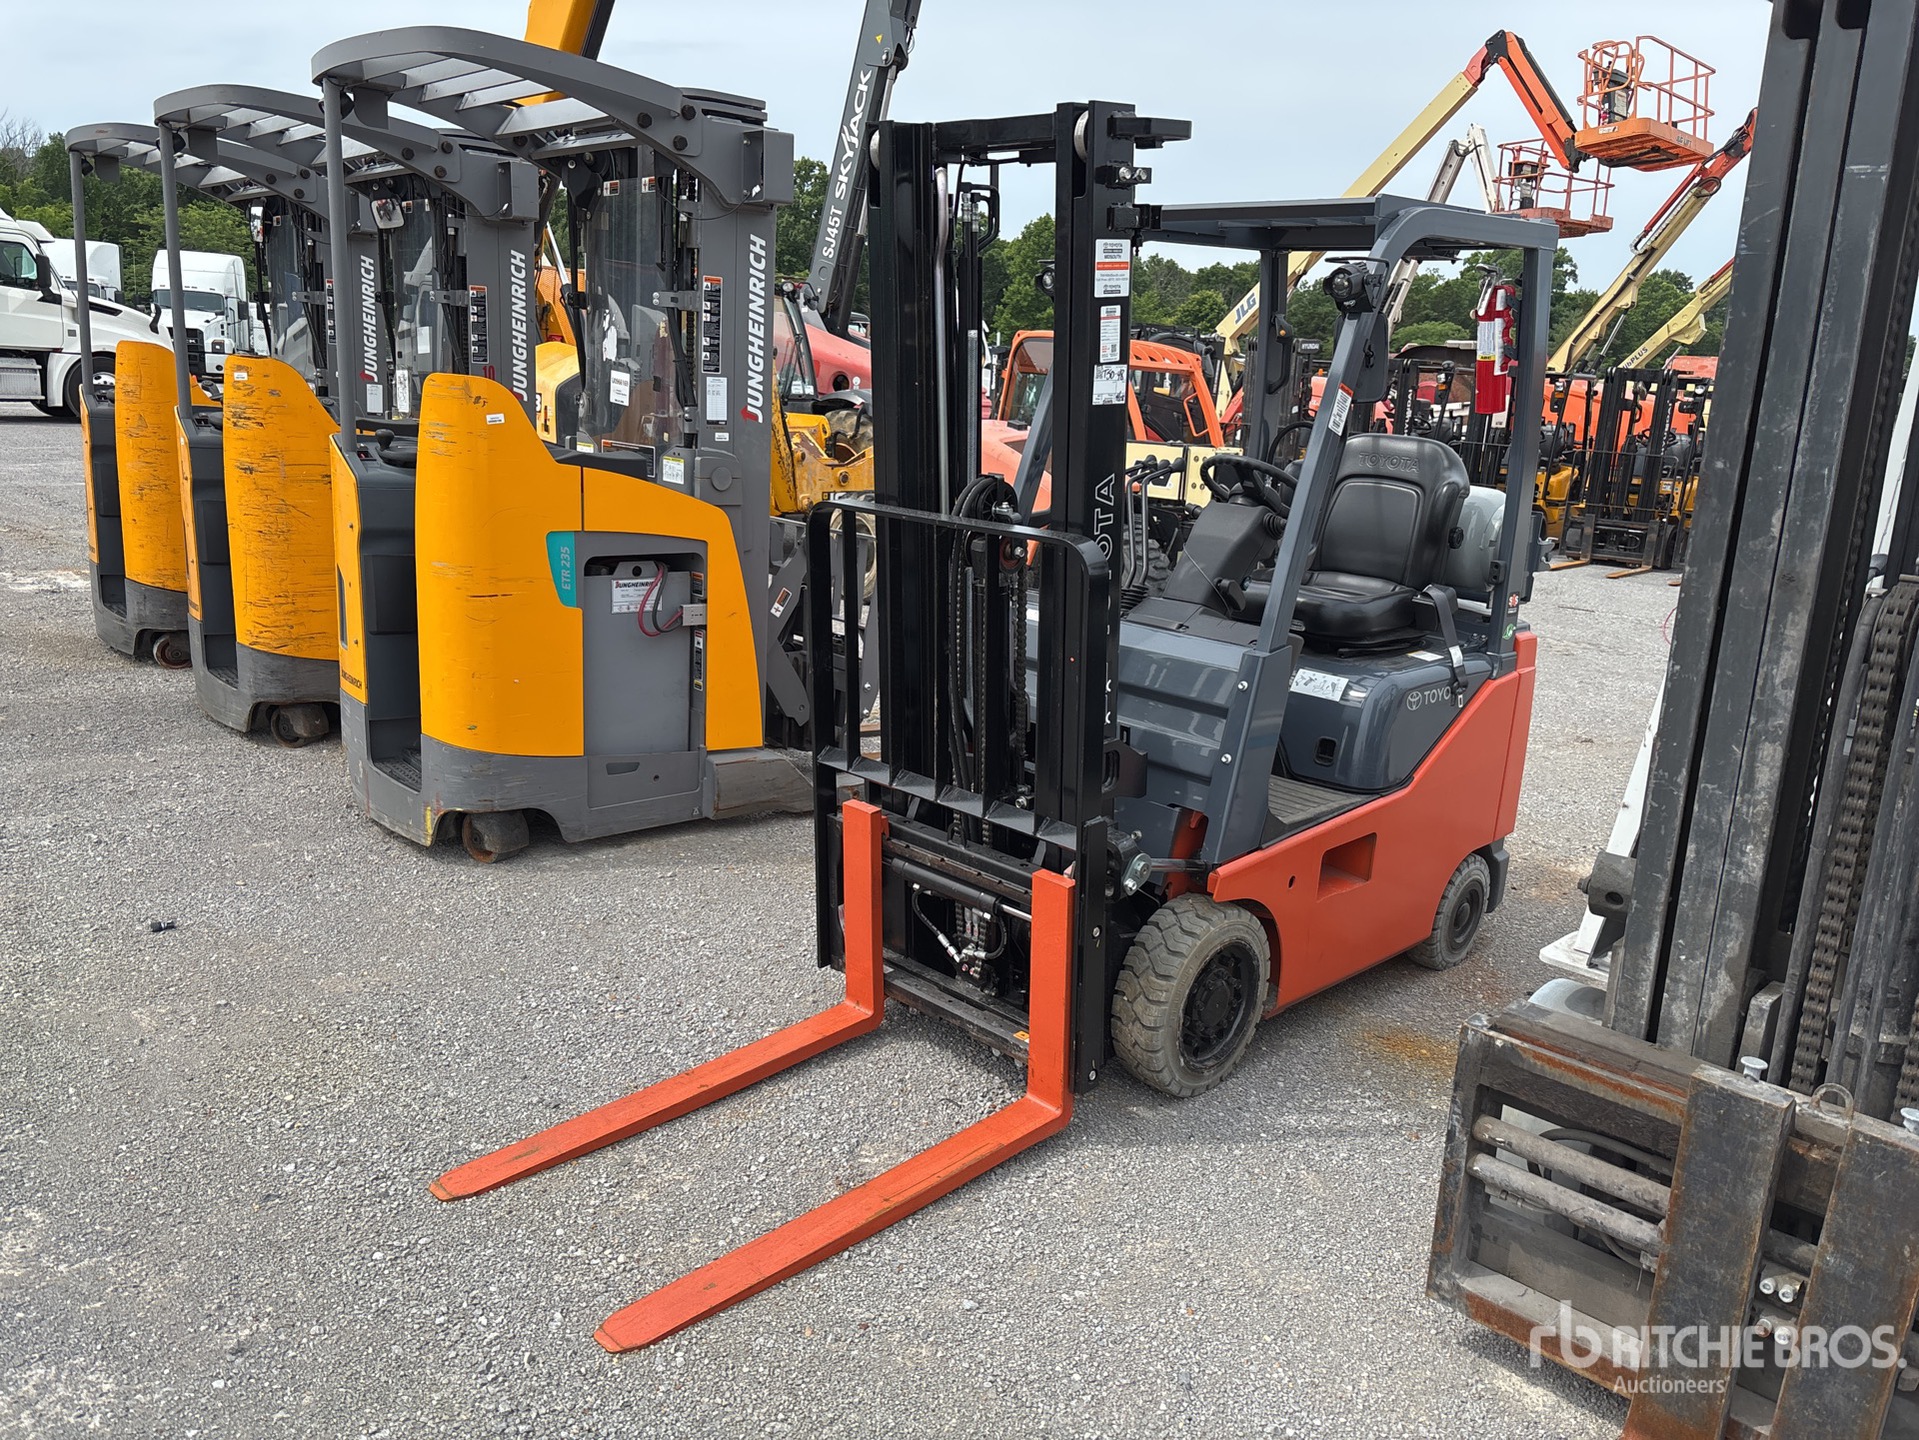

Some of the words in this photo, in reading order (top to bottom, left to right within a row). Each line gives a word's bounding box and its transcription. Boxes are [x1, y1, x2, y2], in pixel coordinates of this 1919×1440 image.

[822, 204, 843, 259] SJ45T
[835, 69, 872, 200] SKYJACK
[360, 254, 379, 383] JUNGHEINRICH
[1234, 291, 1257, 325] JLG
[511, 249, 528, 402] JUNGHEINRICH
[747, 233, 766, 424] JUNGHEINRICH
[1359, 452, 1420, 474] TOYOTA
[560, 546, 570, 569] 235
[561, 569, 571, 590] ETR
[1424, 685, 1452, 705] TOYO
